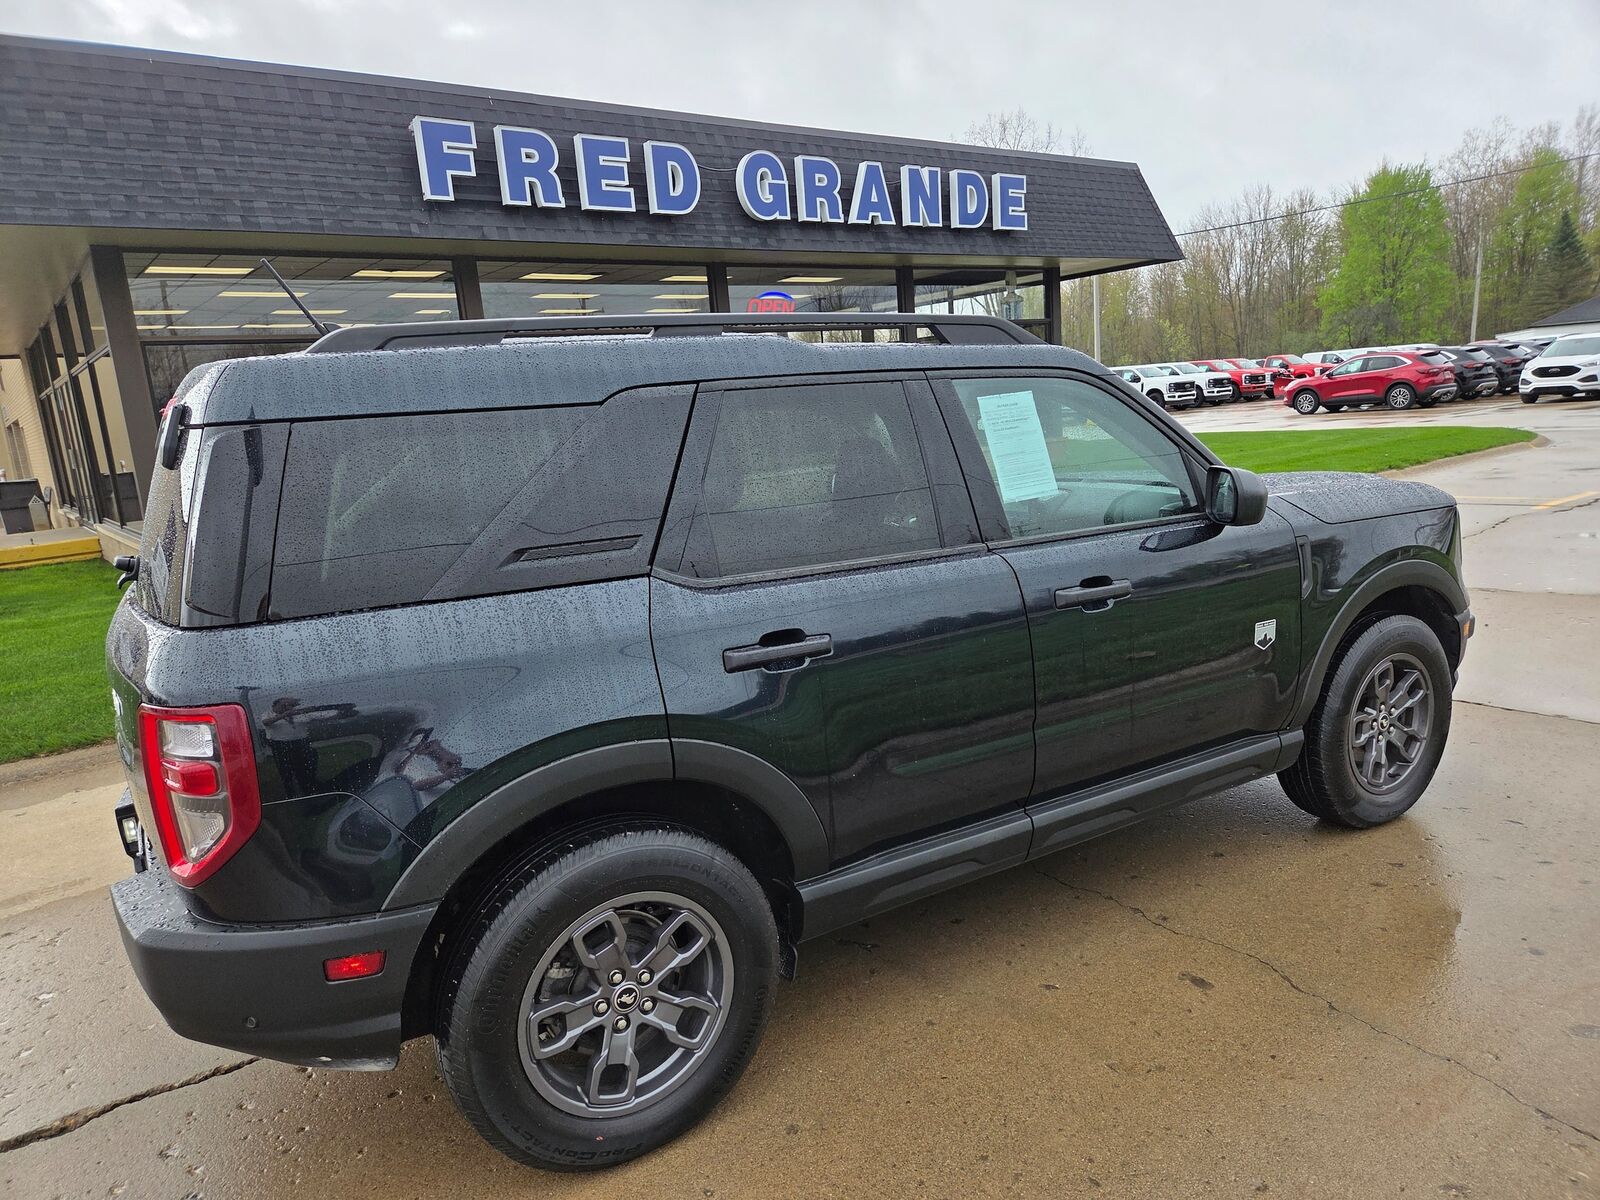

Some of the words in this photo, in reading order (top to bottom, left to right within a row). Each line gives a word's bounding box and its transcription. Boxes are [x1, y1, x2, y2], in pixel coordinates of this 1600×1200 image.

[411, 115, 701, 215] FRED
[736, 150, 1029, 231] GRANDE
[746, 297, 796, 313] OPEN
